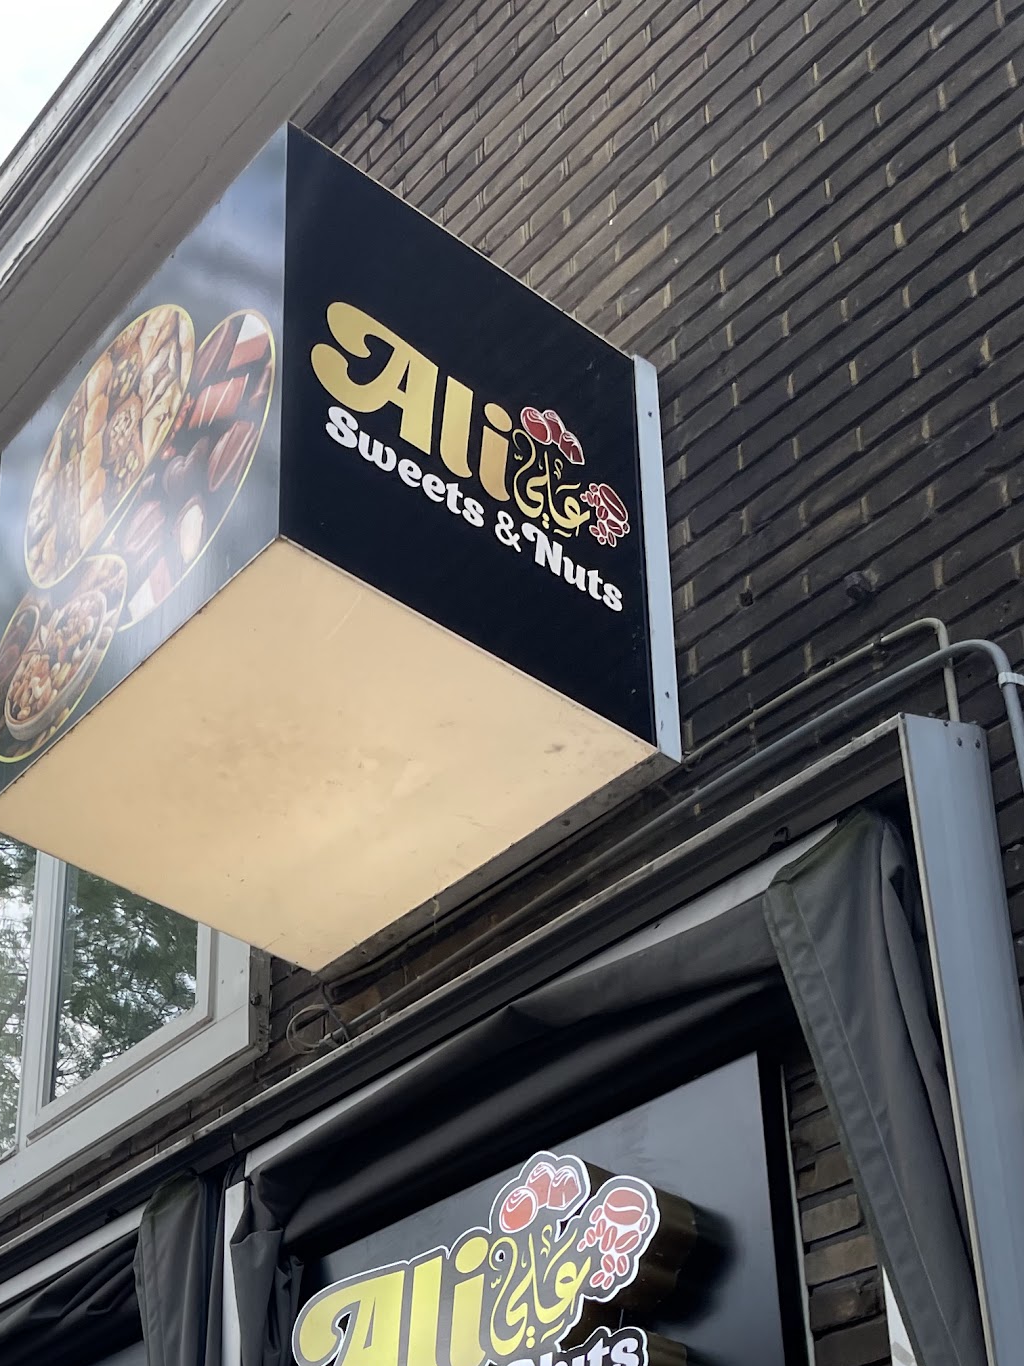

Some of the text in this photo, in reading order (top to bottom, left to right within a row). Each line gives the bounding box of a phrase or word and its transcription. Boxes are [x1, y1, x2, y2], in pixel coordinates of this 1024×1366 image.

[311, 301, 513, 502] Ali
[325, 406, 624, 612] Sweets & Nuts
